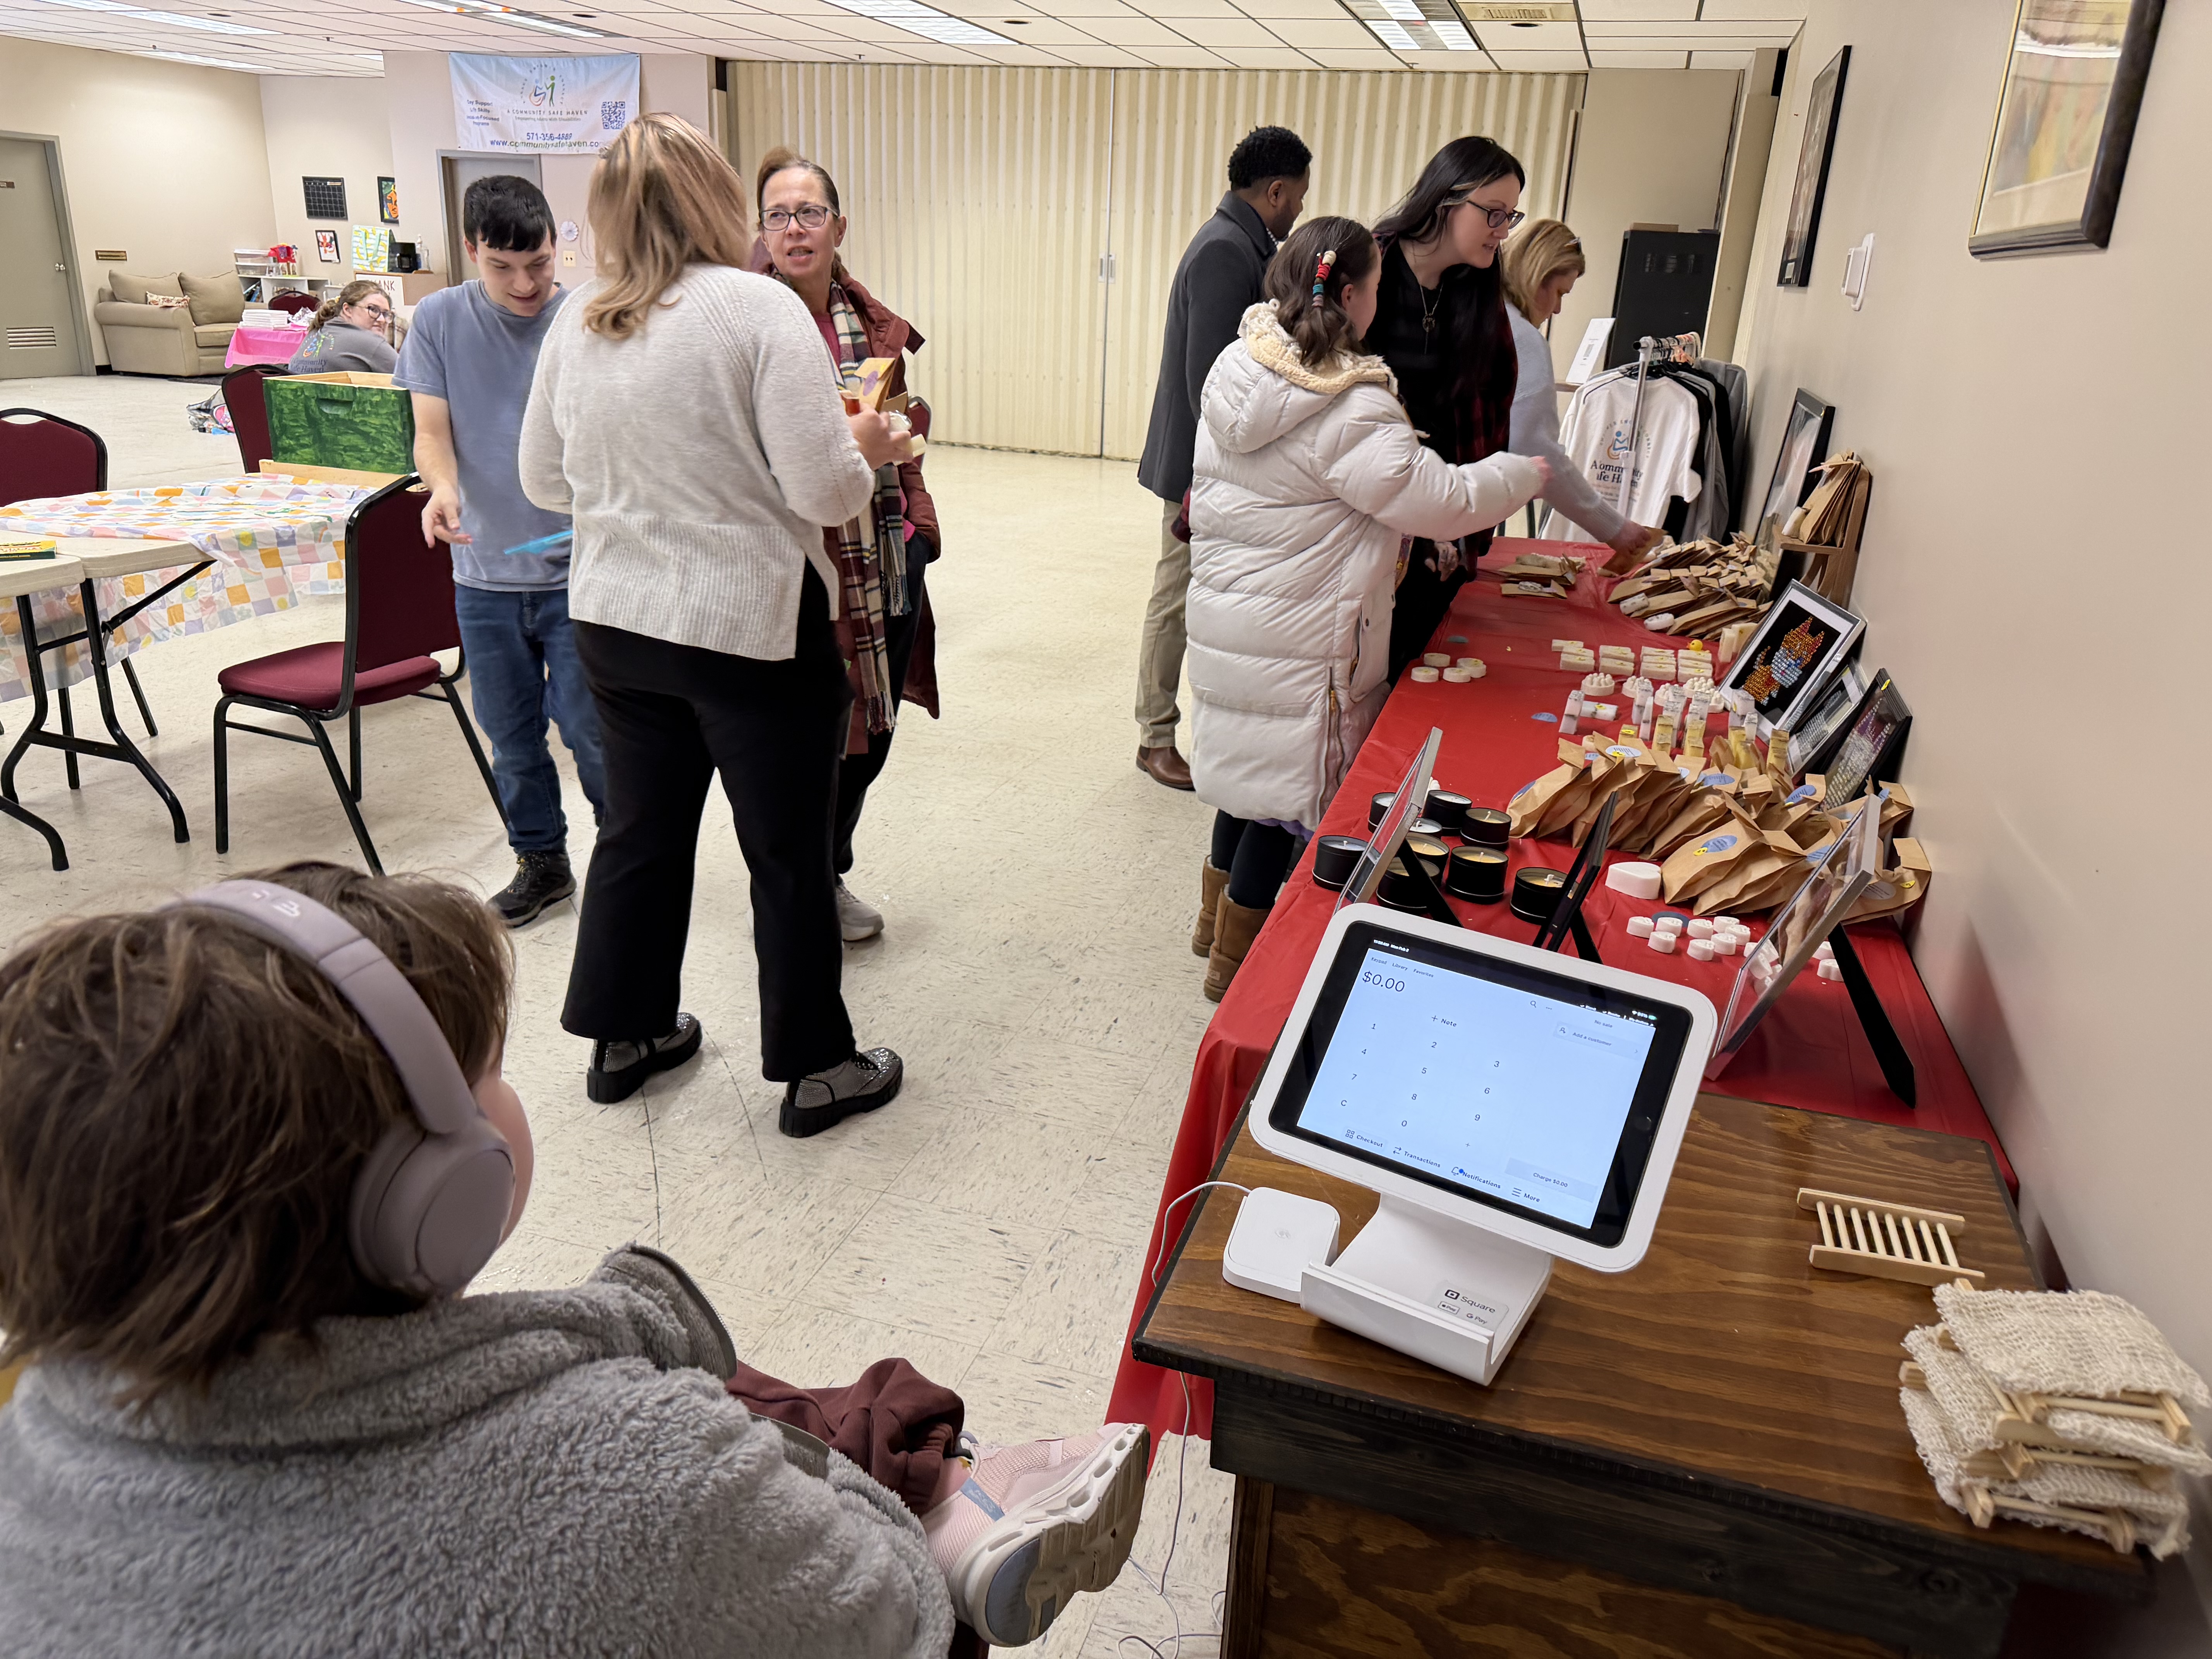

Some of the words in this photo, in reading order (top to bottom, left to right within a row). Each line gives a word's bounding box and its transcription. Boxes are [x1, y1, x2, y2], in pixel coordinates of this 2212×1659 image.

[371, 280, 395, 291] ANK
[1392, 962, 1408, 971] Library
[1413, 969, 1434, 978] Favorites
[1362, 970, 1405, 992] $0.00
[1441, 1018, 1457, 1027] Note
[1588, 1037, 1612, 1046] customer
[1357, 1135, 1383, 1148] Checkout
[1404, 1151, 1441, 1168] Transactions
[1463, 1171, 1501, 1189] Notifications
[1533, 1172, 1552, 1183] Charge
[1553, 1178, 1568, 1188] $0.00
[1523, 1193, 1540, 1202] More
[1460, 1296, 1496, 1313] Square
[1475, 1316, 1488, 1324] Pay
